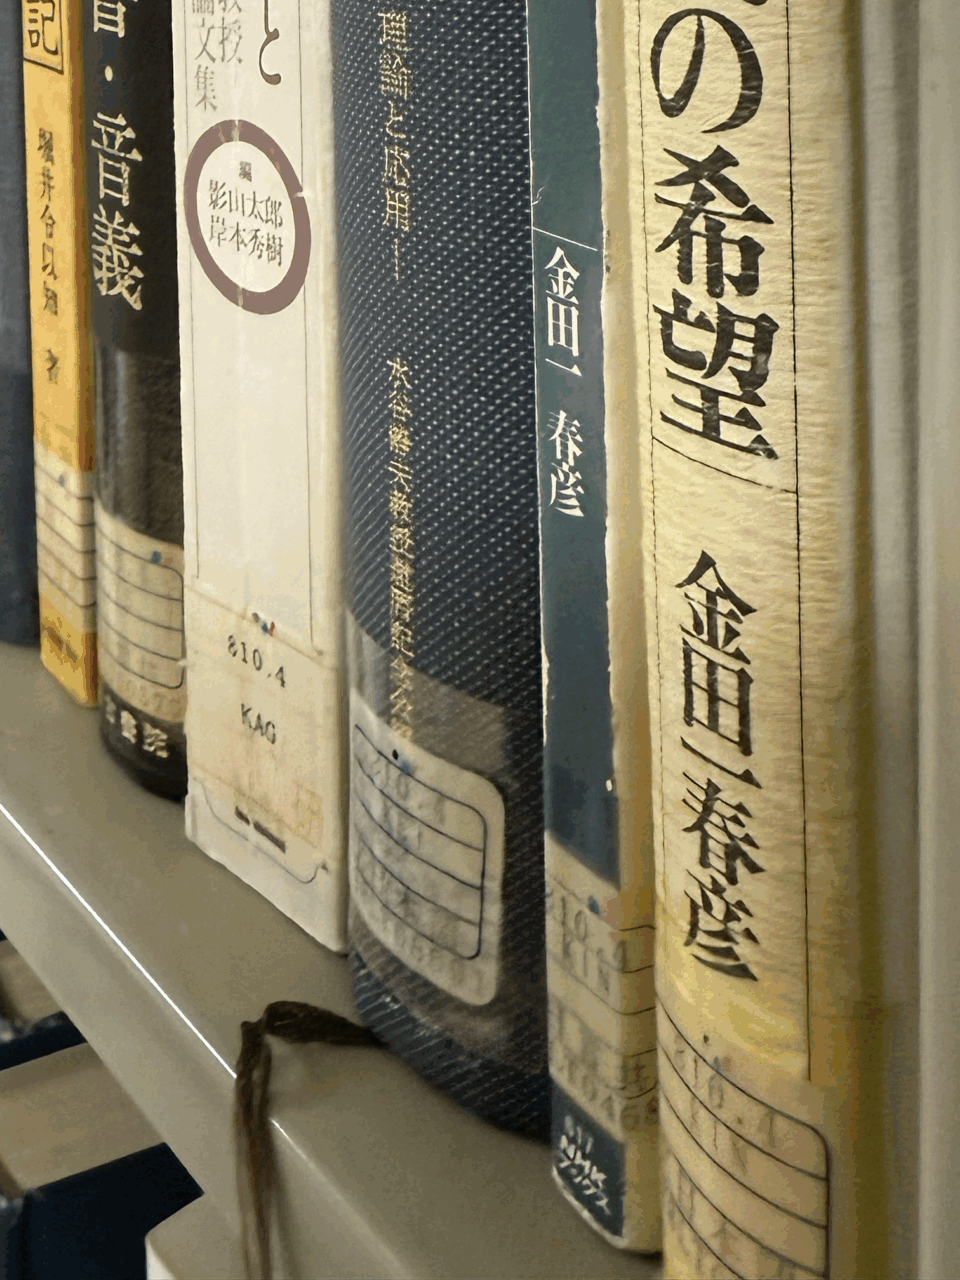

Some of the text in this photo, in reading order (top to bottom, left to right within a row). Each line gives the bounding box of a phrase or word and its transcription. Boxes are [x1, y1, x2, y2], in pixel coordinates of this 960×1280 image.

[208, 179, 284, 229] 影山太郎
[208, 214, 284, 268] 岸本秀樹
[674, 549, 766, 982] 金田一春彦
